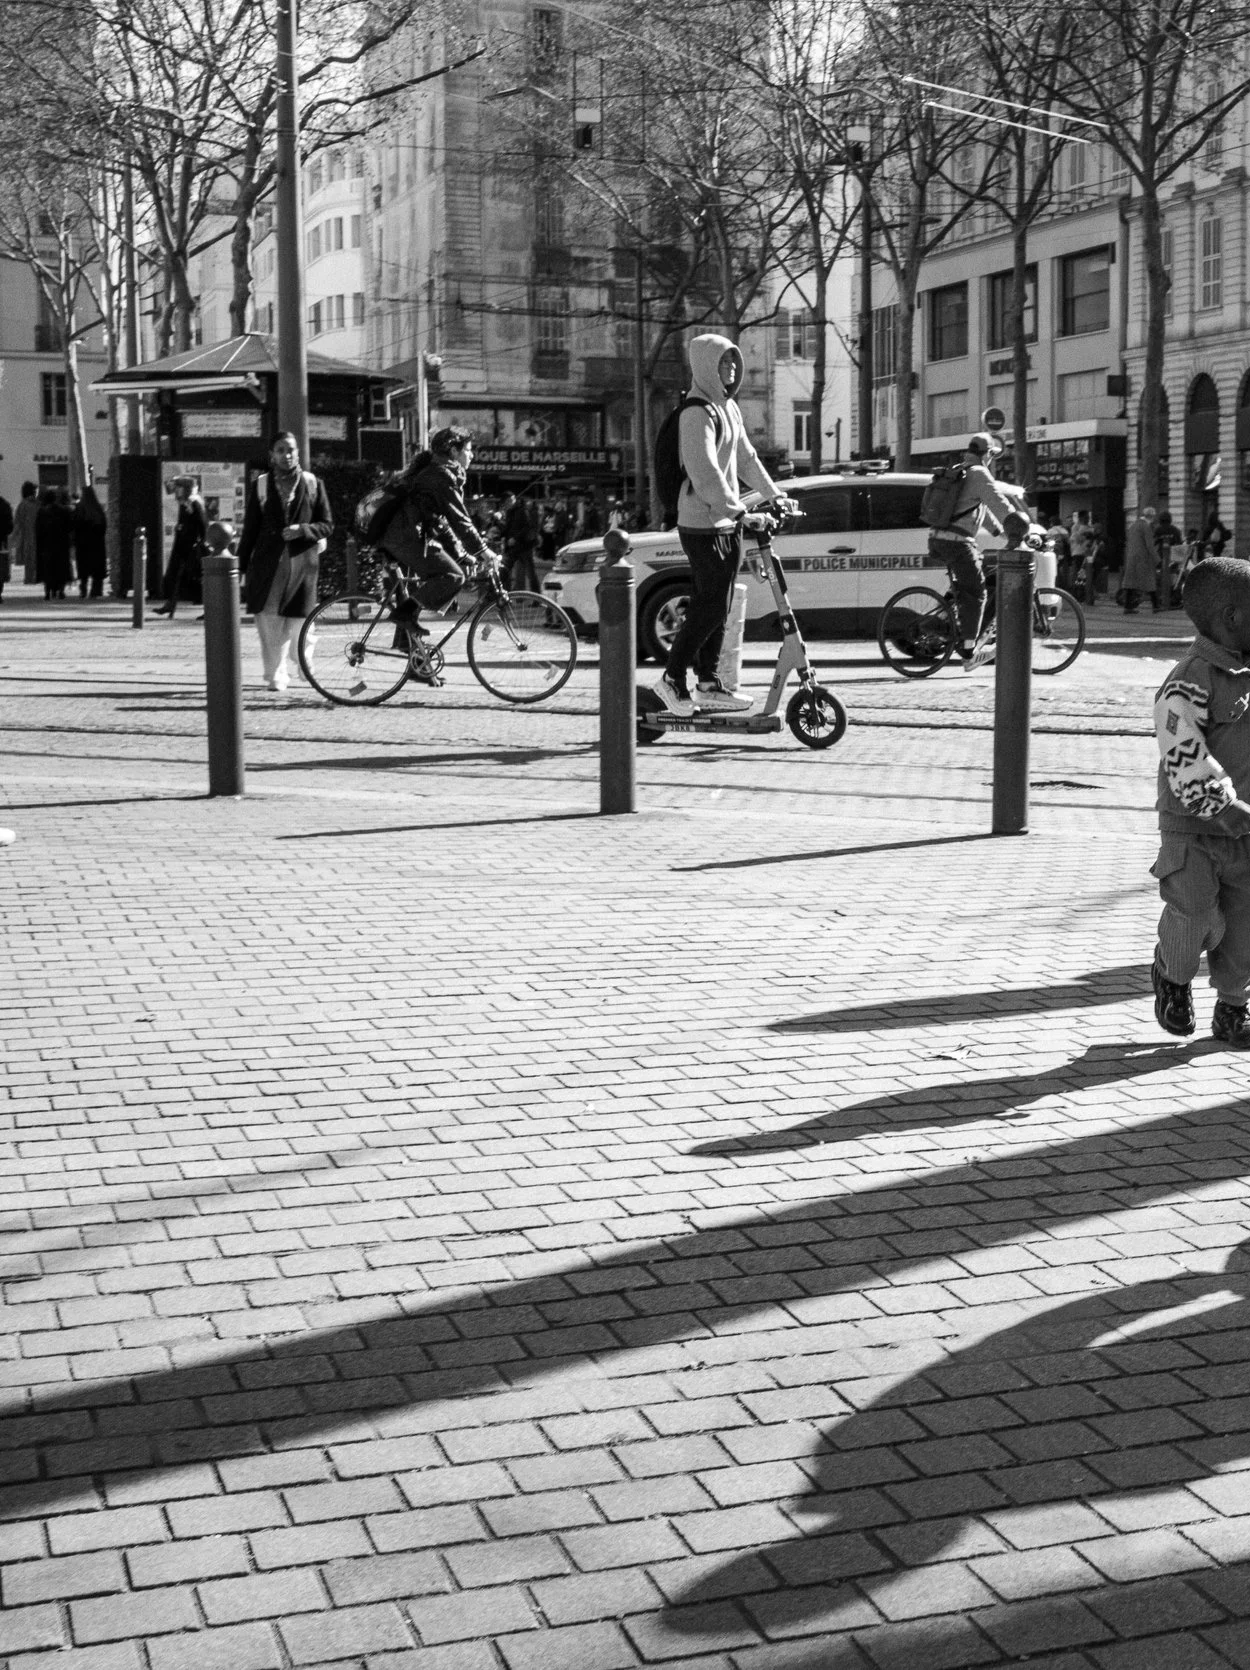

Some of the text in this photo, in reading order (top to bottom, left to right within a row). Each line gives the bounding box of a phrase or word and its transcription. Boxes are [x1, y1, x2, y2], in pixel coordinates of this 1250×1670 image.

[475, 451, 606, 463] IQUE DE MARSEILLE
[803, 556, 921, 570] POLICE MUNICIPALE
